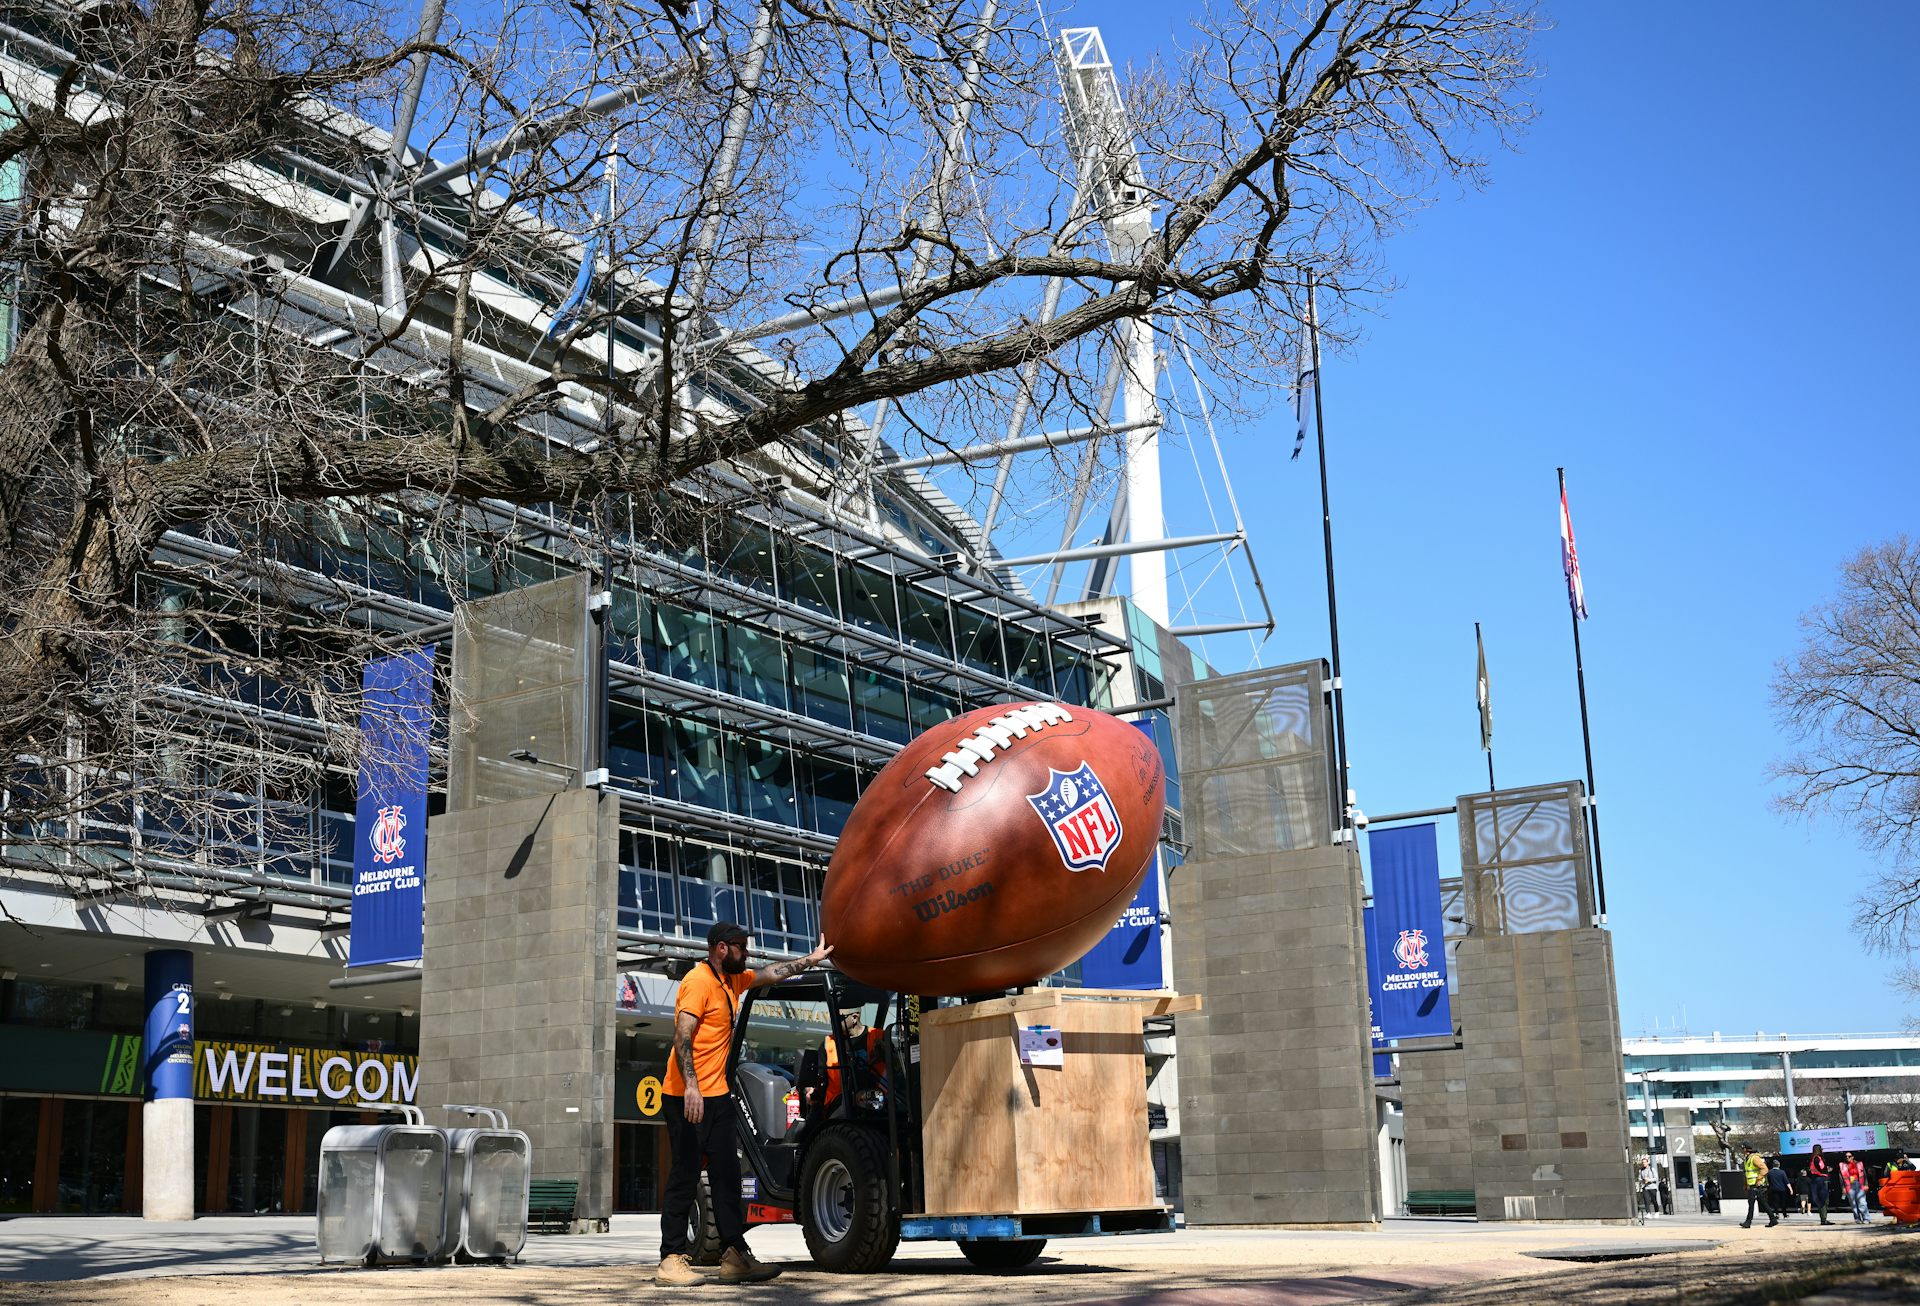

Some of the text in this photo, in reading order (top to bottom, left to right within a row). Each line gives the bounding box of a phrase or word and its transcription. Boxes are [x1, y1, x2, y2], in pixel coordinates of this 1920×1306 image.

[1058, 800, 1116, 860] NFL
[360, 866, 414, 883] MELBOURNE
[354, 877, 420, 896] CRICKET CLUB
[912, 881, 993, 922] Wilson
[1129, 916, 1156, 926] CLUB
[1382, 979, 1445, 991] CRICKET CLUB
[1386, 972, 1439, 982] MELBOURNE
[172, 983, 192, 992] GATE
[177, 993, 190, 1014] 2
[205, 1048, 420, 1102] WELCOM
[644, 1087, 655, 1109] 2
[1674, 1136, 1686, 1153] 2
[1797, 1137, 1810, 1145] SHOP
